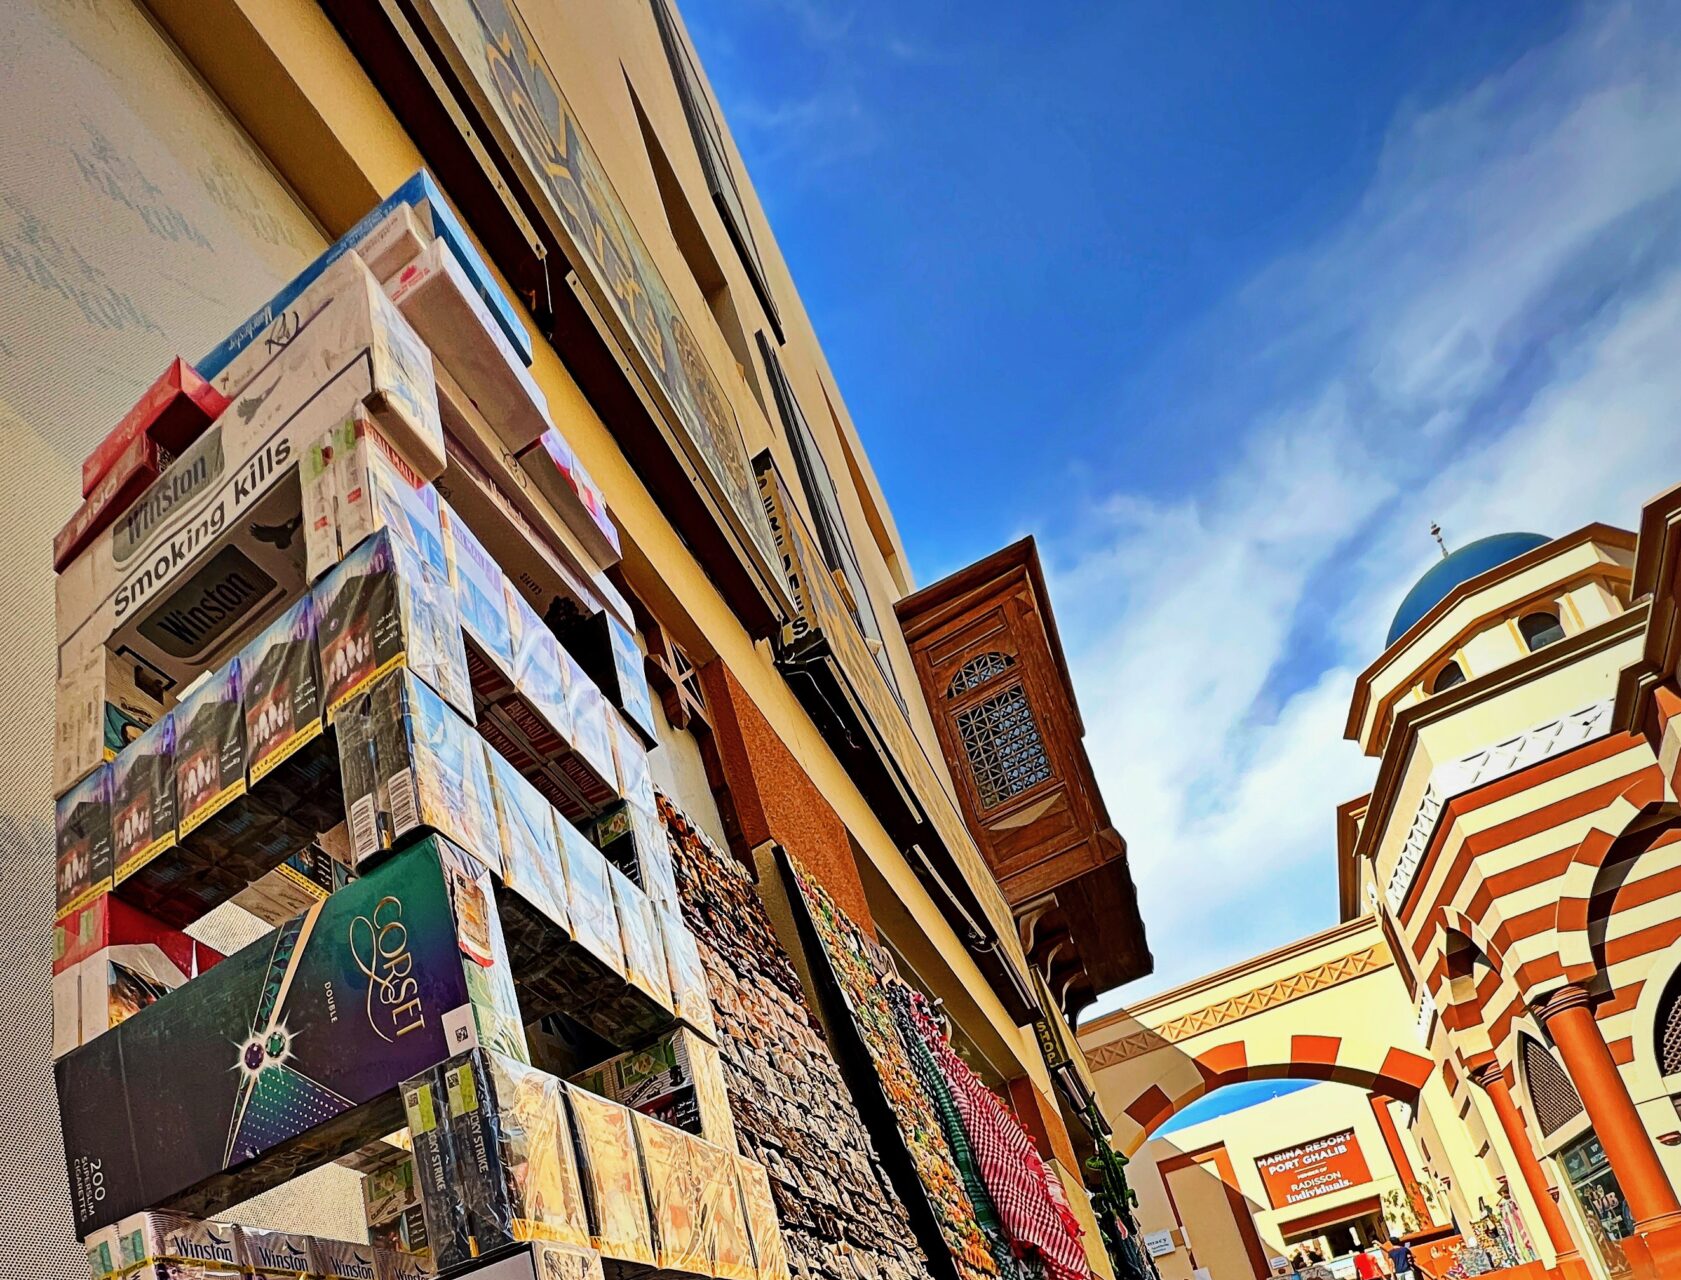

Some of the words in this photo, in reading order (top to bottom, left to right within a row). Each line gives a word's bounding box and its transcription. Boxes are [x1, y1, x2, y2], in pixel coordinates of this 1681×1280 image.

[112, 499, 226, 617] Smoking
[233, 437, 292, 506] kills
[350, 896, 426, 1043] CORSET
[324, 981, 339, 1024] DOUBLE
[468, 1110, 482, 1135] UCKY
[473, 1135, 489, 1174] STRIKE
[1257, 1147, 1303, 1168] MARINA
[1305, 1132, 1352, 1154] RESORT
[1268, 1159, 1300, 1175] PORT
[1302, 1144, 1348, 1164] GHALIB
[73, 1158, 89, 1223] CIGARETTES
[80, 1156, 97, 1217] SUPERSLIM
[89, 1158, 107, 1202] 200
[431, 1155, 447, 1192] STRIKE
[1290, 1171, 1342, 1192] RADISSON
[173, 1233, 235, 1263] Winston
[258, 1245, 309, 1272] Winston
[330, 1255, 375, 1280] Winston
